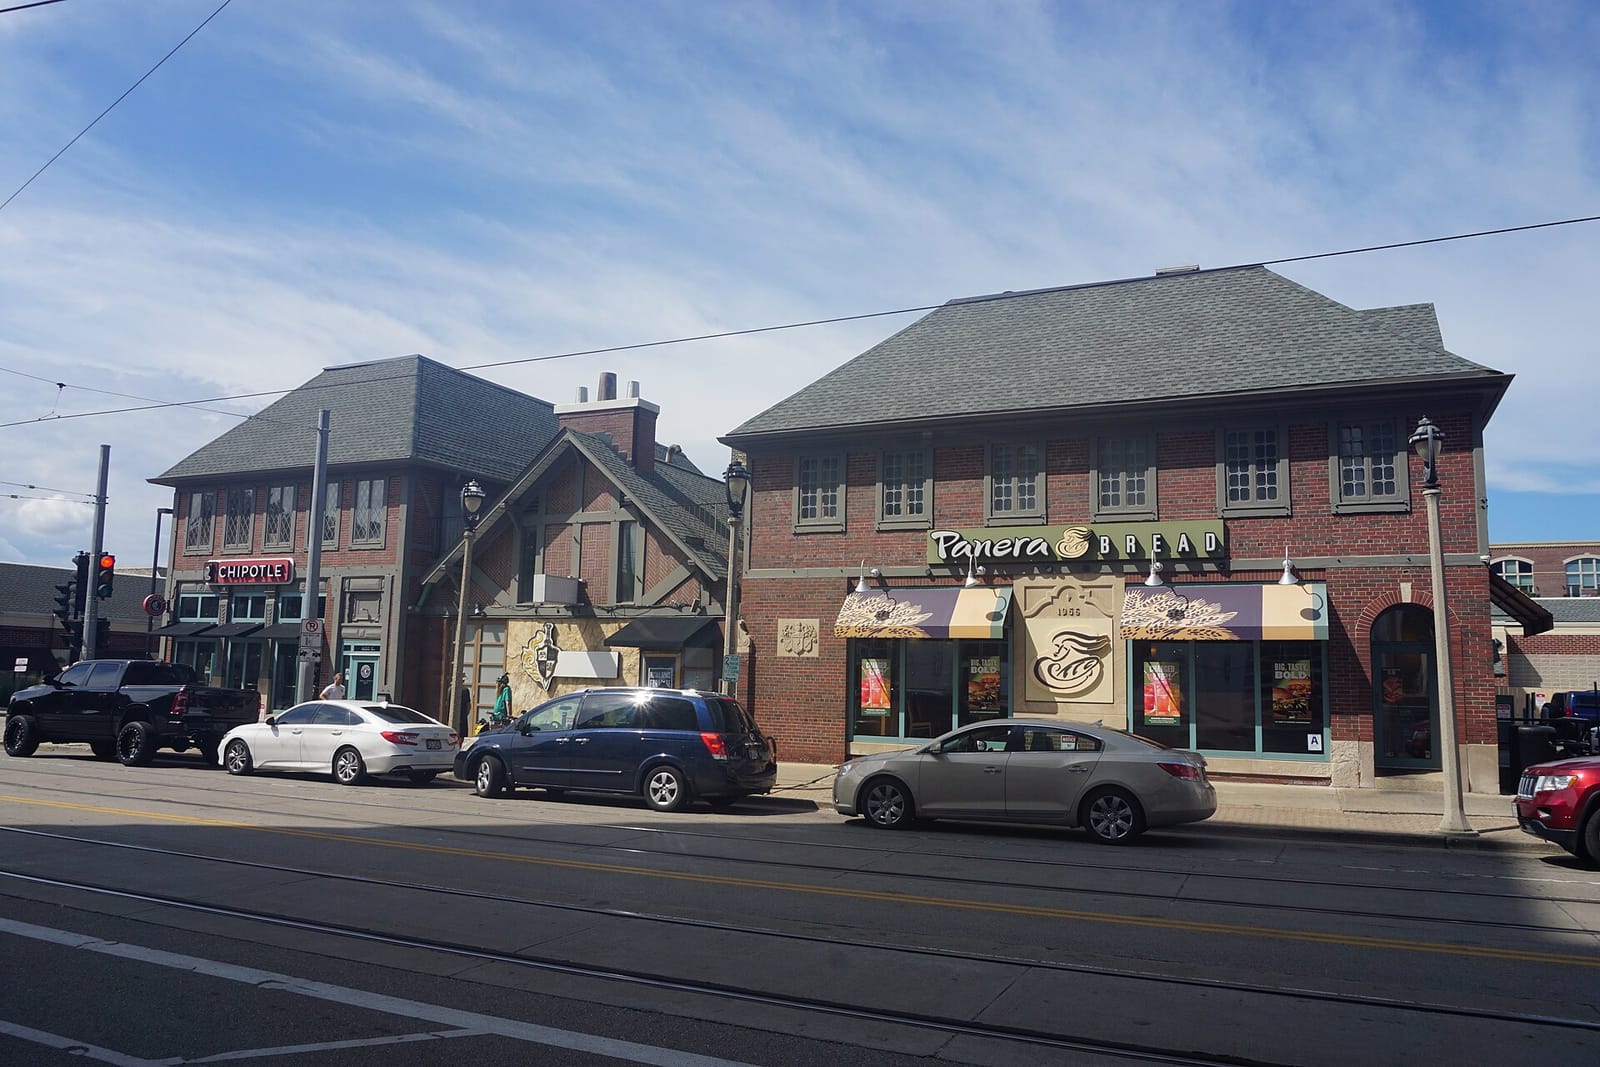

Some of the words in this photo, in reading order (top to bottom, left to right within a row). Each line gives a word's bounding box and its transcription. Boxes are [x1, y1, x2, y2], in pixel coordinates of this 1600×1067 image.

[930, 530, 1049, 560] Panera
[1099, 532, 1217, 554] BREAD
[218, 564, 282, 578] CHIPOTLE
[1274, 671, 1309, 680] BOLD.
[1311, 736, 1319, 745] A
